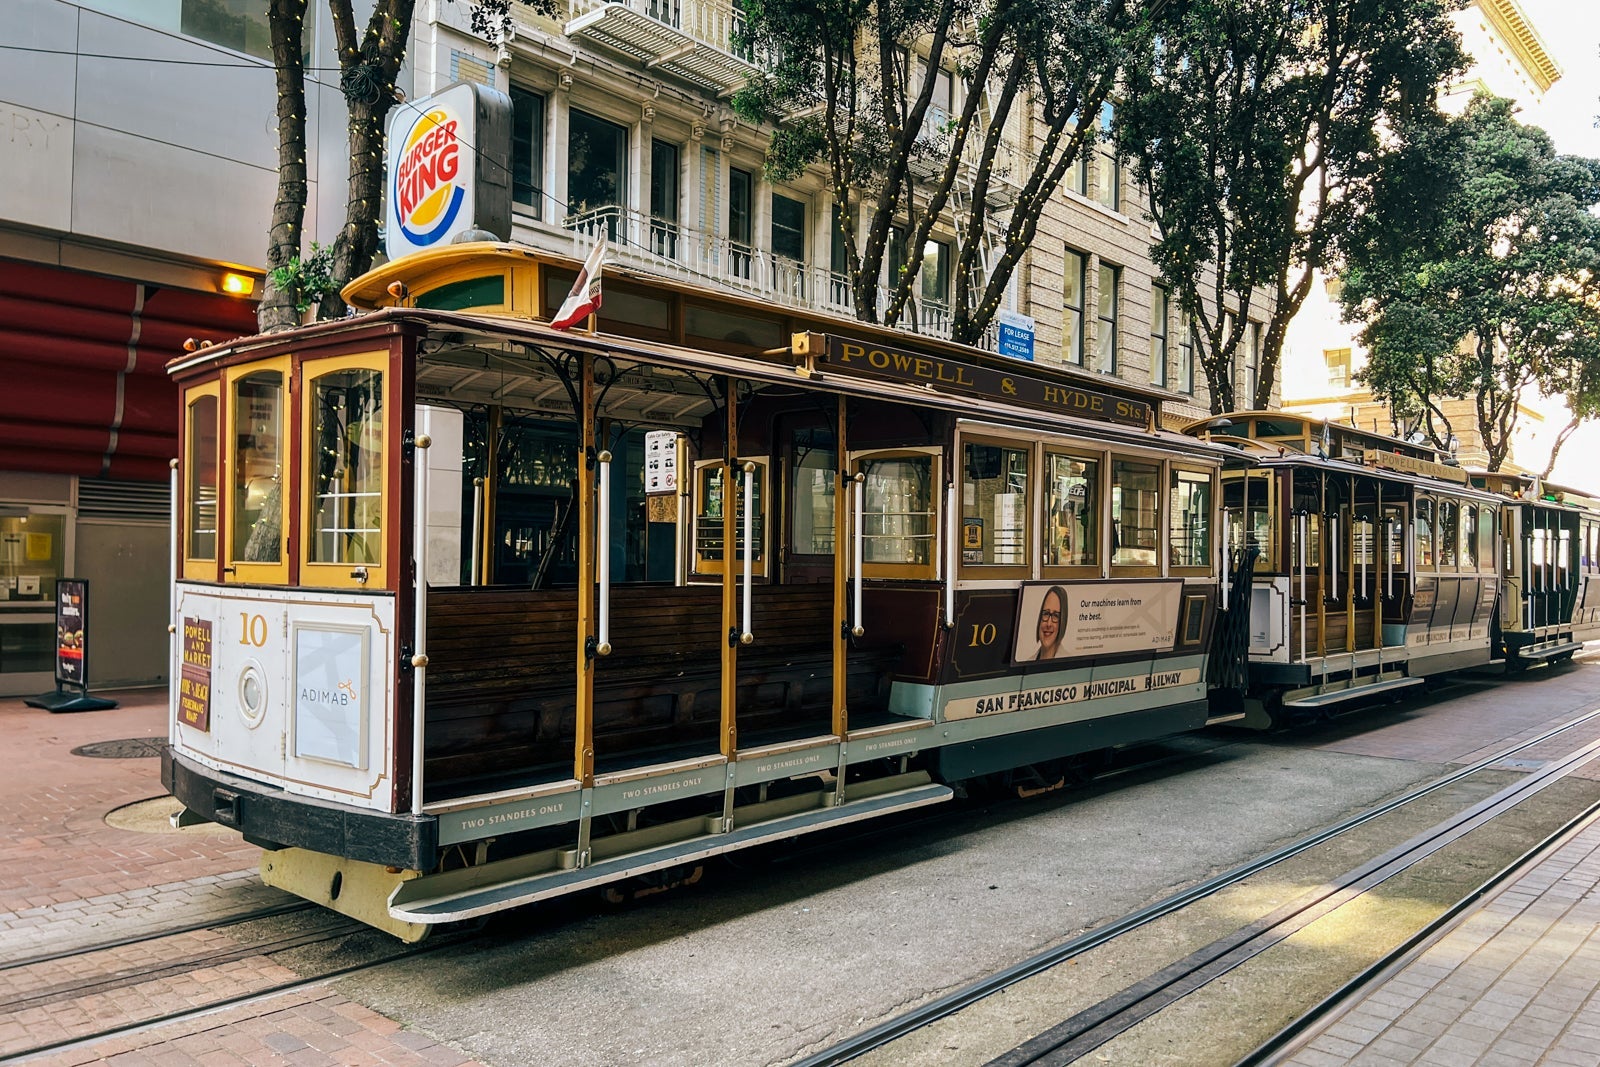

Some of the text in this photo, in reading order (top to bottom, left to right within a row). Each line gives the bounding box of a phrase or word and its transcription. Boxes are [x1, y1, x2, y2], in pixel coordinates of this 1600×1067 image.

[399, 120, 457, 190] BURGER
[400, 143, 459, 225] KING
[1004, 328, 1030, 340] FOR LEASE
[841, 343, 1145, 420] POWELL & HYDE Sts.
[1382, 453, 1417, 470] POWELL
[1080, 600, 1091, 608] Our
[1091, 598, 1116, 607] machines
[1130, 598, 1142, 606] from
[1089, 612, 1101, 621] best.
[185, 625, 211, 642] POWELL
[239, 612, 268, 647] 10
[968, 623, 996, 647] 10
[191, 641, 205, 652] AND
[184, 650, 211, 668] MARKET
[301, 688, 348, 706] ADIMAB
[975, 672, 1181, 714] SAN FRANCISCO MUNICIPAL RAILWAY
[878, 740, 903, 750] STANDEES
[904, 737, 917, 745] ONLY
[757, 755, 820, 773] TWO STANDEES ONLY
[623, 778, 702, 799] TWO STANDEES ONLY
[462, 803, 564, 830] TWO STANDEES ONLY
